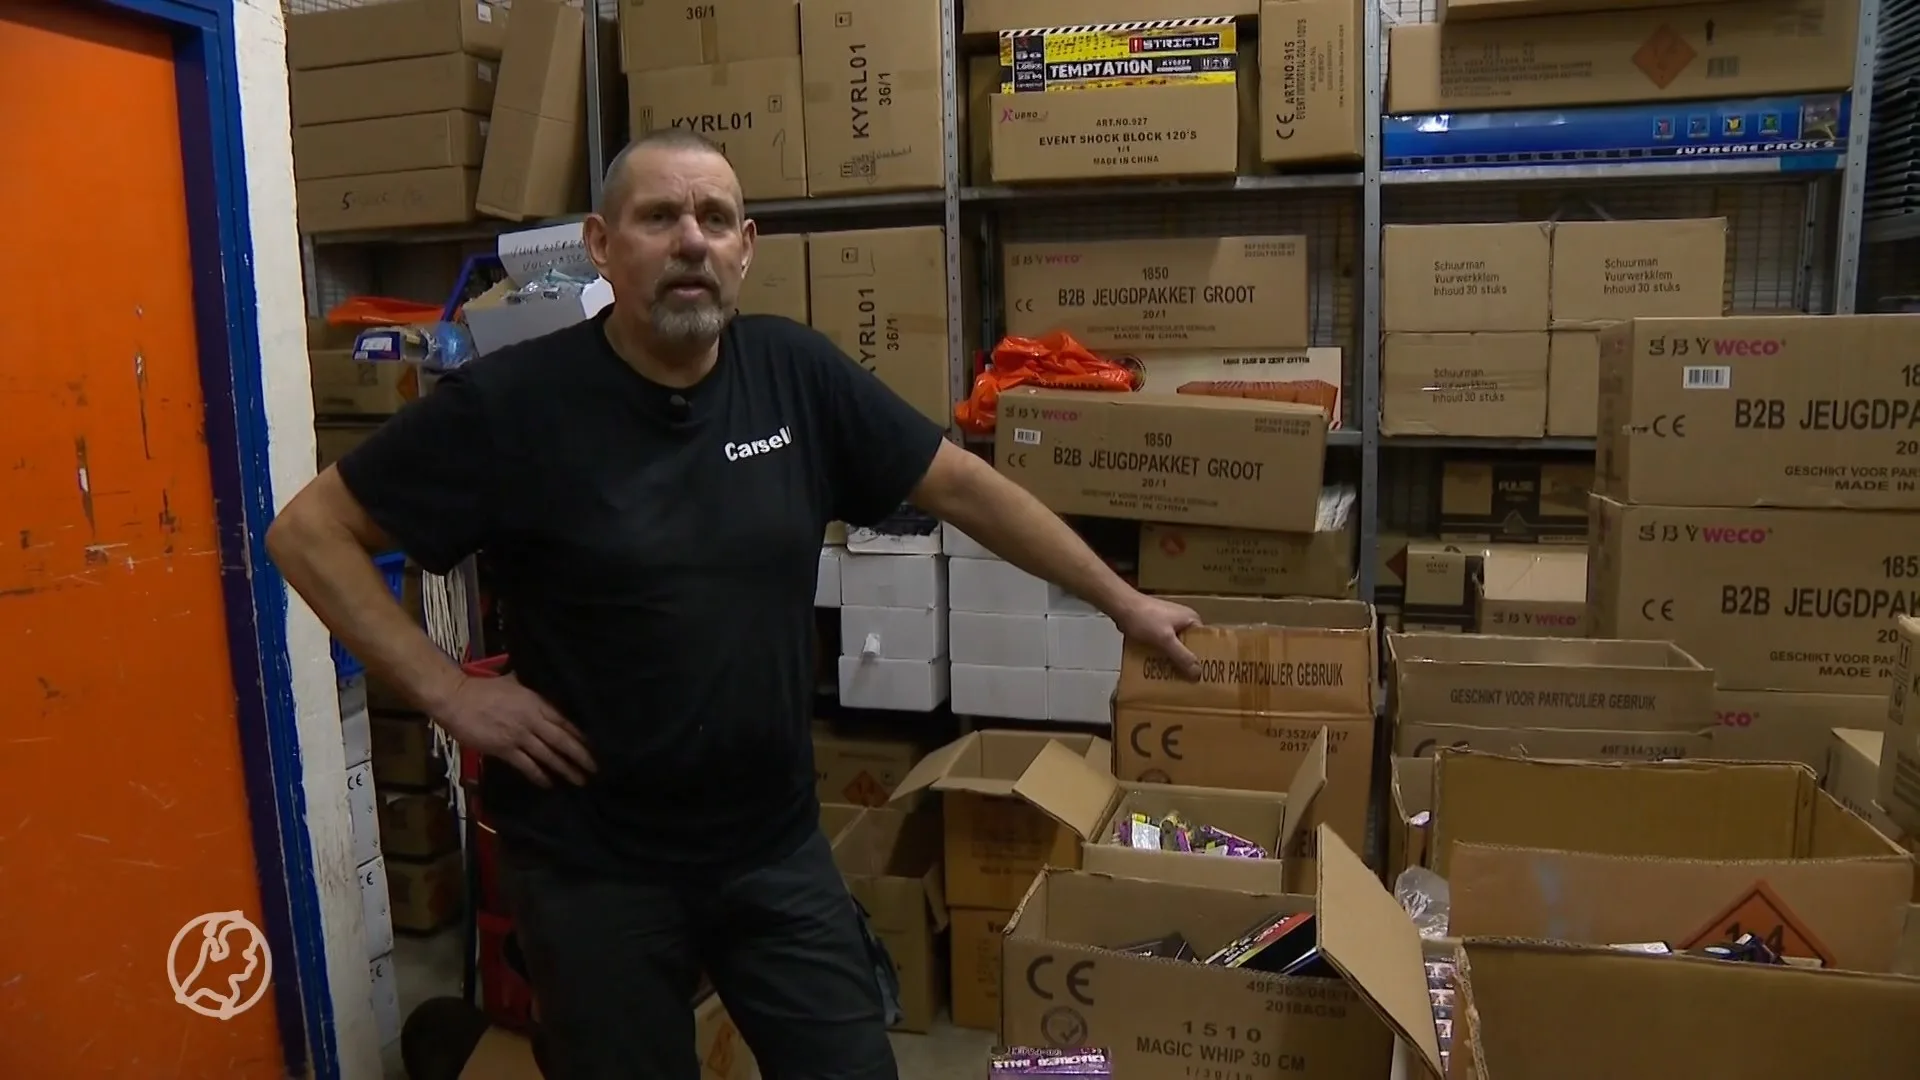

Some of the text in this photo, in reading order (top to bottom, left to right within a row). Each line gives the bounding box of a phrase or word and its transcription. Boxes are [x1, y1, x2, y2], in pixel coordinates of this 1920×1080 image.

[685, 6, 716, 20] 36/1
[1050, 59, 1153, 79] TEMPTATION
[850, 43, 869, 139] KYRL01
[878, 72, 891, 106] 36/1
[672, 111, 752, 132] KYRL01
[1096, 117, 1148, 127] ART.NO.927
[1039, 130, 1197, 146] EVENT SHOCK BLOCK 120'S
[1676, 144, 1758, 155] SUPREME
[1093, 156, 1118, 165] MADE
[1132, 155, 1159, 164] CHINA
[1434, 260, 1485, 271] Schuurman
[1604, 257, 1658, 269] Schuurman
[1142, 267, 1169, 281] 1850
[1058, 285, 1256, 306] B2B JEUGDPAKKET GROOT
[1434, 284, 1507, 297] Inhoud 30 stuks
[1603, 282, 1680, 295] Inhoud 30 stuks
[1143, 310, 1166, 319] 20/1
[858, 288, 876, 373] YRL01
[887, 318, 899, 351] 36/1
[1713, 338, 1779, 355] weco
[1433, 367, 1484, 379] Schuurman
[1901, 364, 1920, 387] 18
[1433, 391, 1505, 403] Inhoud 30 stuks
[1734, 398, 1920, 430] B2B JEUGDPA
[1144, 432, 1172, 448] 1850
[1896, 440, 1918, 455] 20
[1054, 446, 1264, 481] B2B JEUGDPAKKET GROOT
[1785, 465, 1846, 477] GESCHIKT
[1851, 465, 1887, 477] VOOR
[1142, 478, 1167, 488] 20/1
[1834, 479, 1914, 491] MADE IN
[1703, 526, 1766, 544] weco
[1882, 555, 1920, 578] 185
[1721, 585, 1770, 616] B2B
[1877, 629, 1899, 643] 20
[1770, 650, 1830, 663] GESCHIKT
[1834, 653, 1870, 665] VOOR
[1229, 661, 1294, 686] PARTICULIER
[1297, 662, 1343, 687] GEBRUIK
[1819, 665, 1871, 678] MADE
[1450, 688, 1655, 711] GESCHIKT VOOR PARTICULIER GEBRUIK
[1714, 710, 1752, 727] eco
[1136, 1036, 1306, 1072] MAGIC WHIP 30 CM
